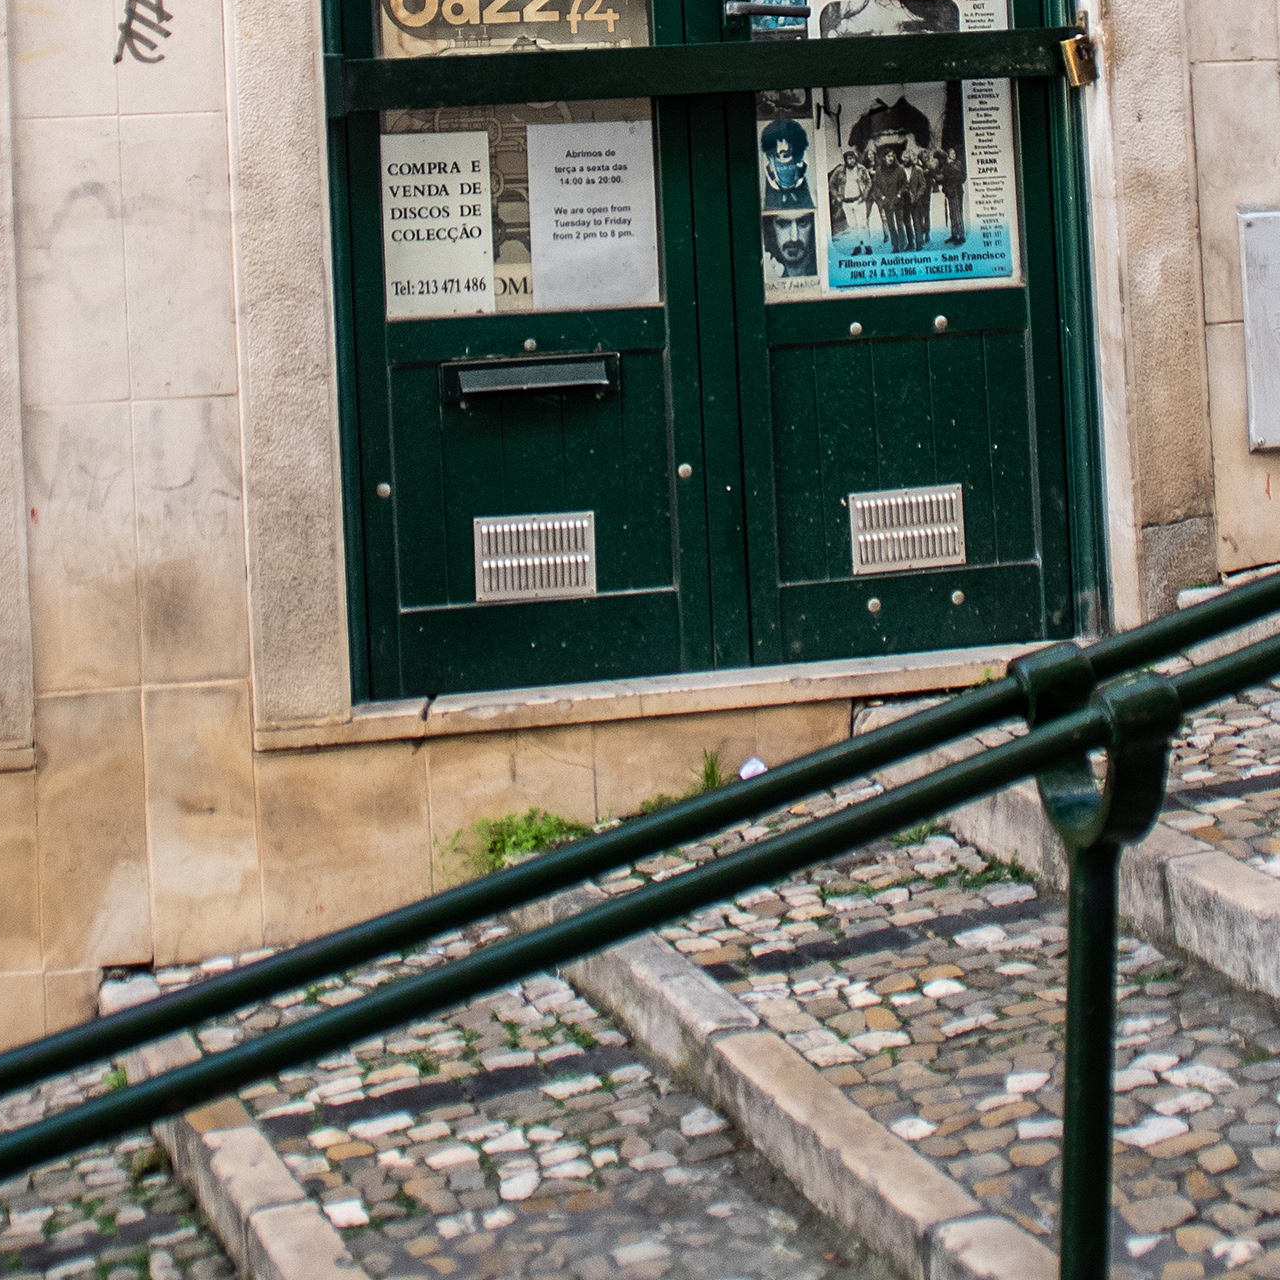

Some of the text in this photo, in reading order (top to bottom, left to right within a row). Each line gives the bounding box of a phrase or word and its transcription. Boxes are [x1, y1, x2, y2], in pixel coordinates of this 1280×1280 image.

[566, 150, 602, 158] Abrimos
[387, 160, 481, 176] COMPRA E
[555, 166, 576, 174] terça
[586, 164, 609, 172] sexta
[560, 177, 583, 185] 14:00
[389, 182, 482, 197] VENDA DE
[390, 205, 481, 220] DISCOS DE
[586, 206, 608, 214] open
[555, 219, 591, 227] Tuesday
[605, 217, 631, 225] Friday
[391, 223, 482, 243] COLECÇÃO
[553, 232, 573, 240] from
[576, 231, 580, 239] 2
[583, 232, 597, 240] pm
[838, 251, 1005, 268] Fillmore Auditorium San Francisco
[851, 270, 865, 279] JUNE
[869, 270, 878, 278] 24
[926, 265, 952, 275] TICKETS
[391, 277, 486, 296] Tel: 213 471 486
